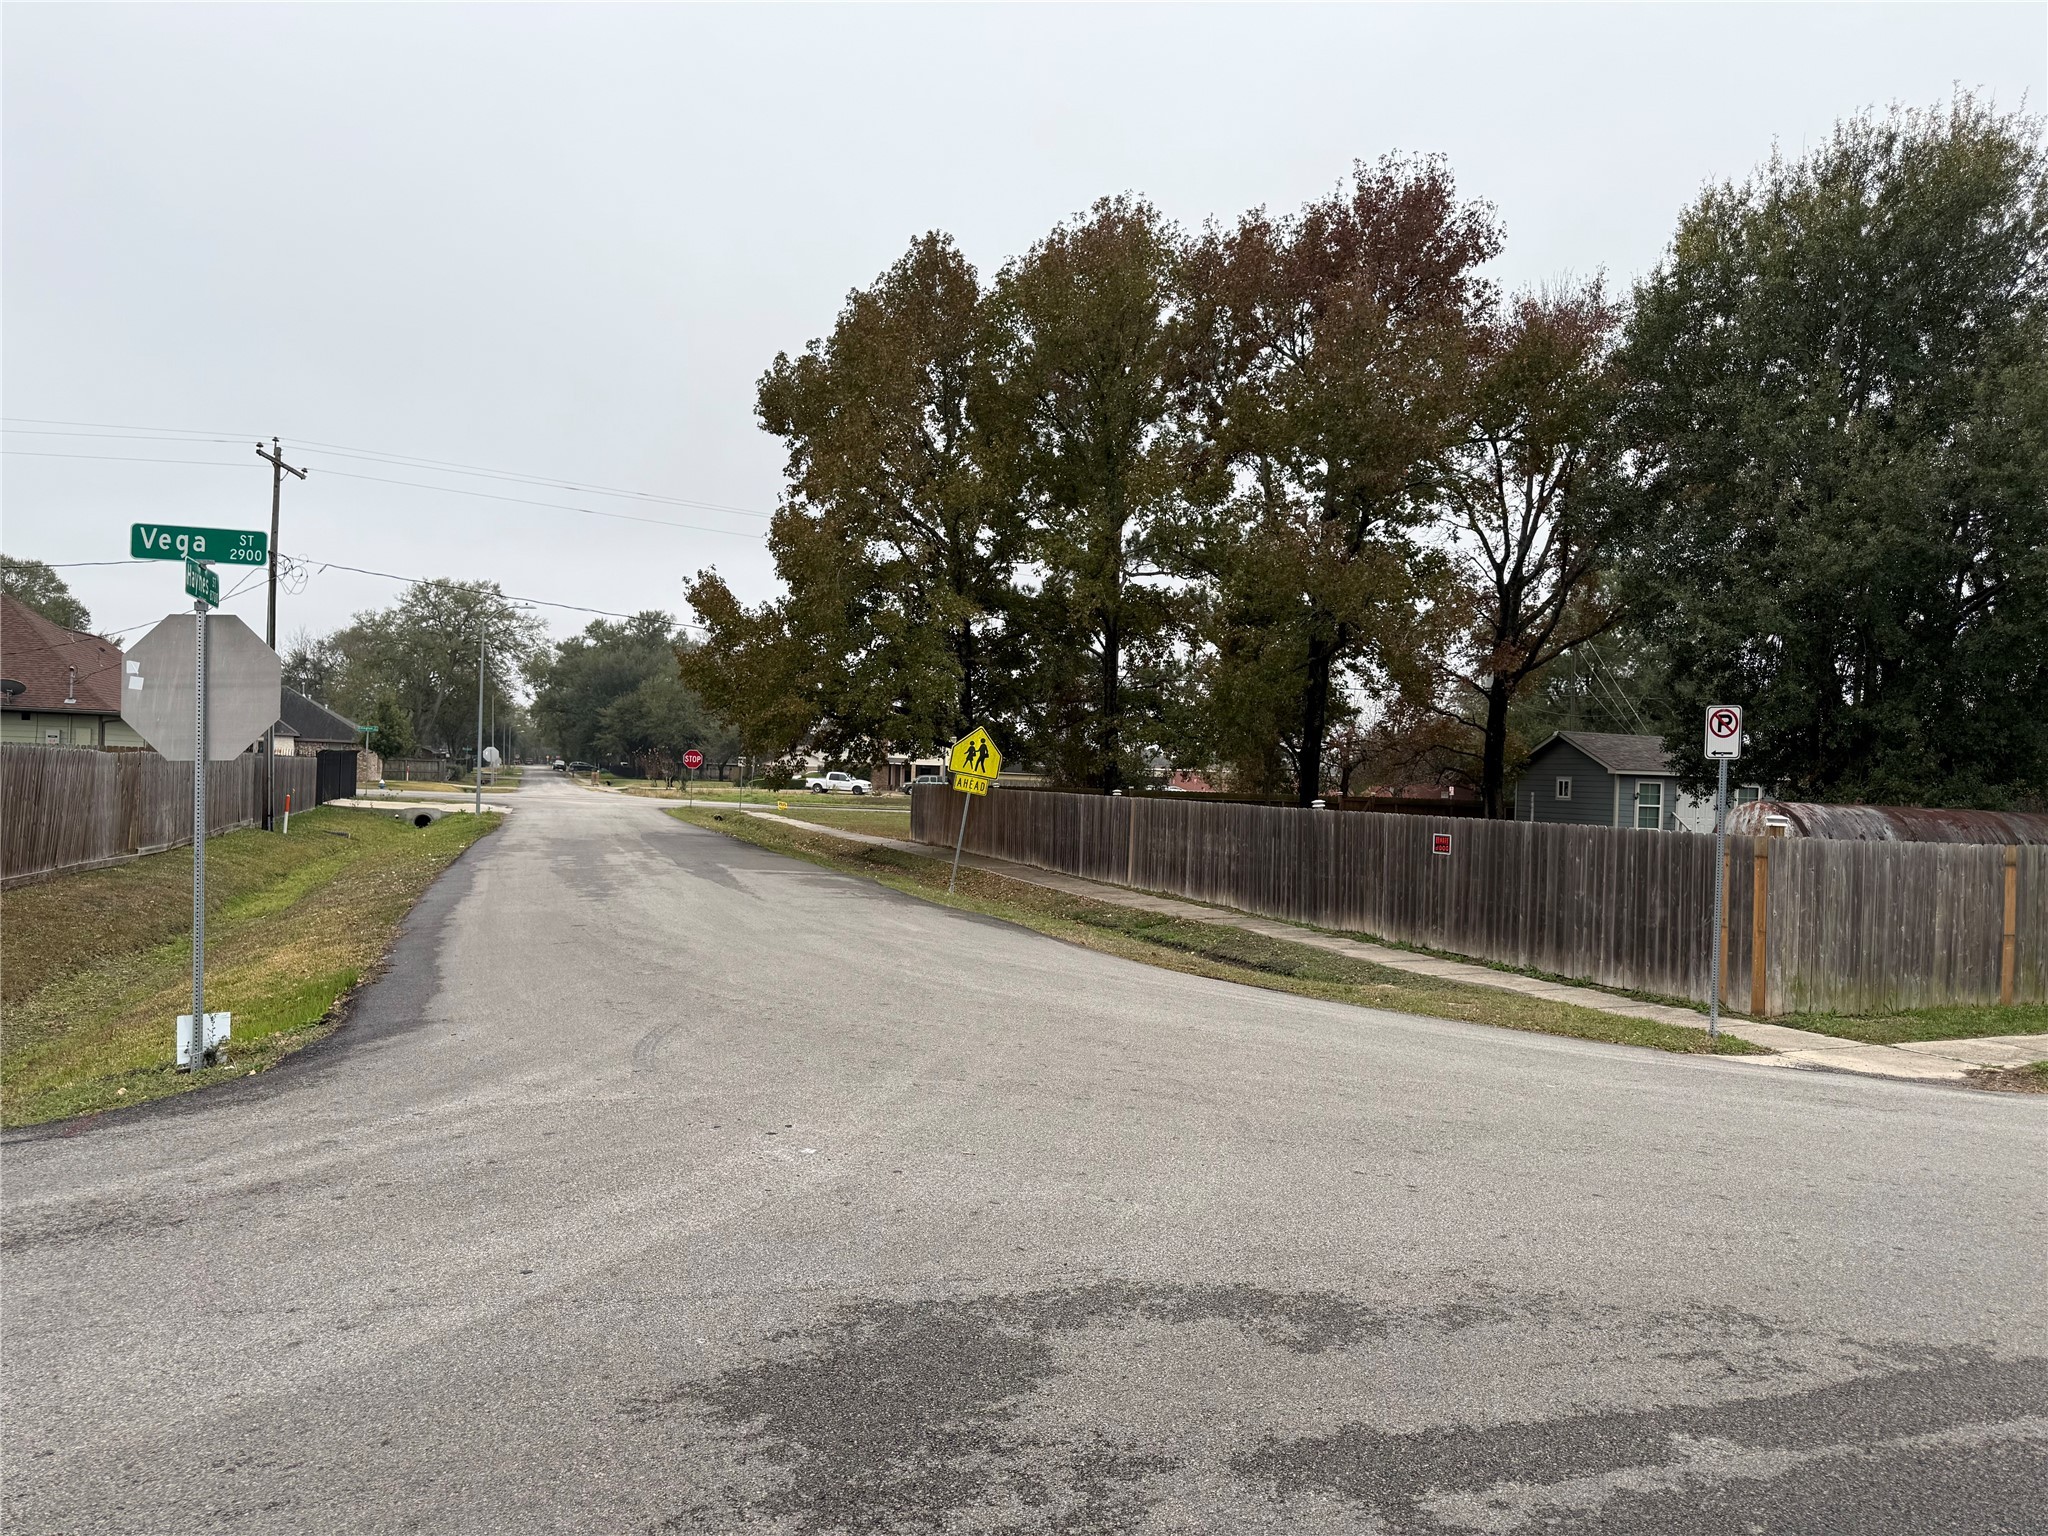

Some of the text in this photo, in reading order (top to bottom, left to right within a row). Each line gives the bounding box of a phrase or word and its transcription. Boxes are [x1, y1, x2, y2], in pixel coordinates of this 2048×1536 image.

[140, 527, 255, 558] Vega ST
[229, 549, 263, 561] 2900
[187, 563, 209, 595] Haynes
[684, 755, 701, 763] STOP
[957, 778, 986, 791] AHEAD
